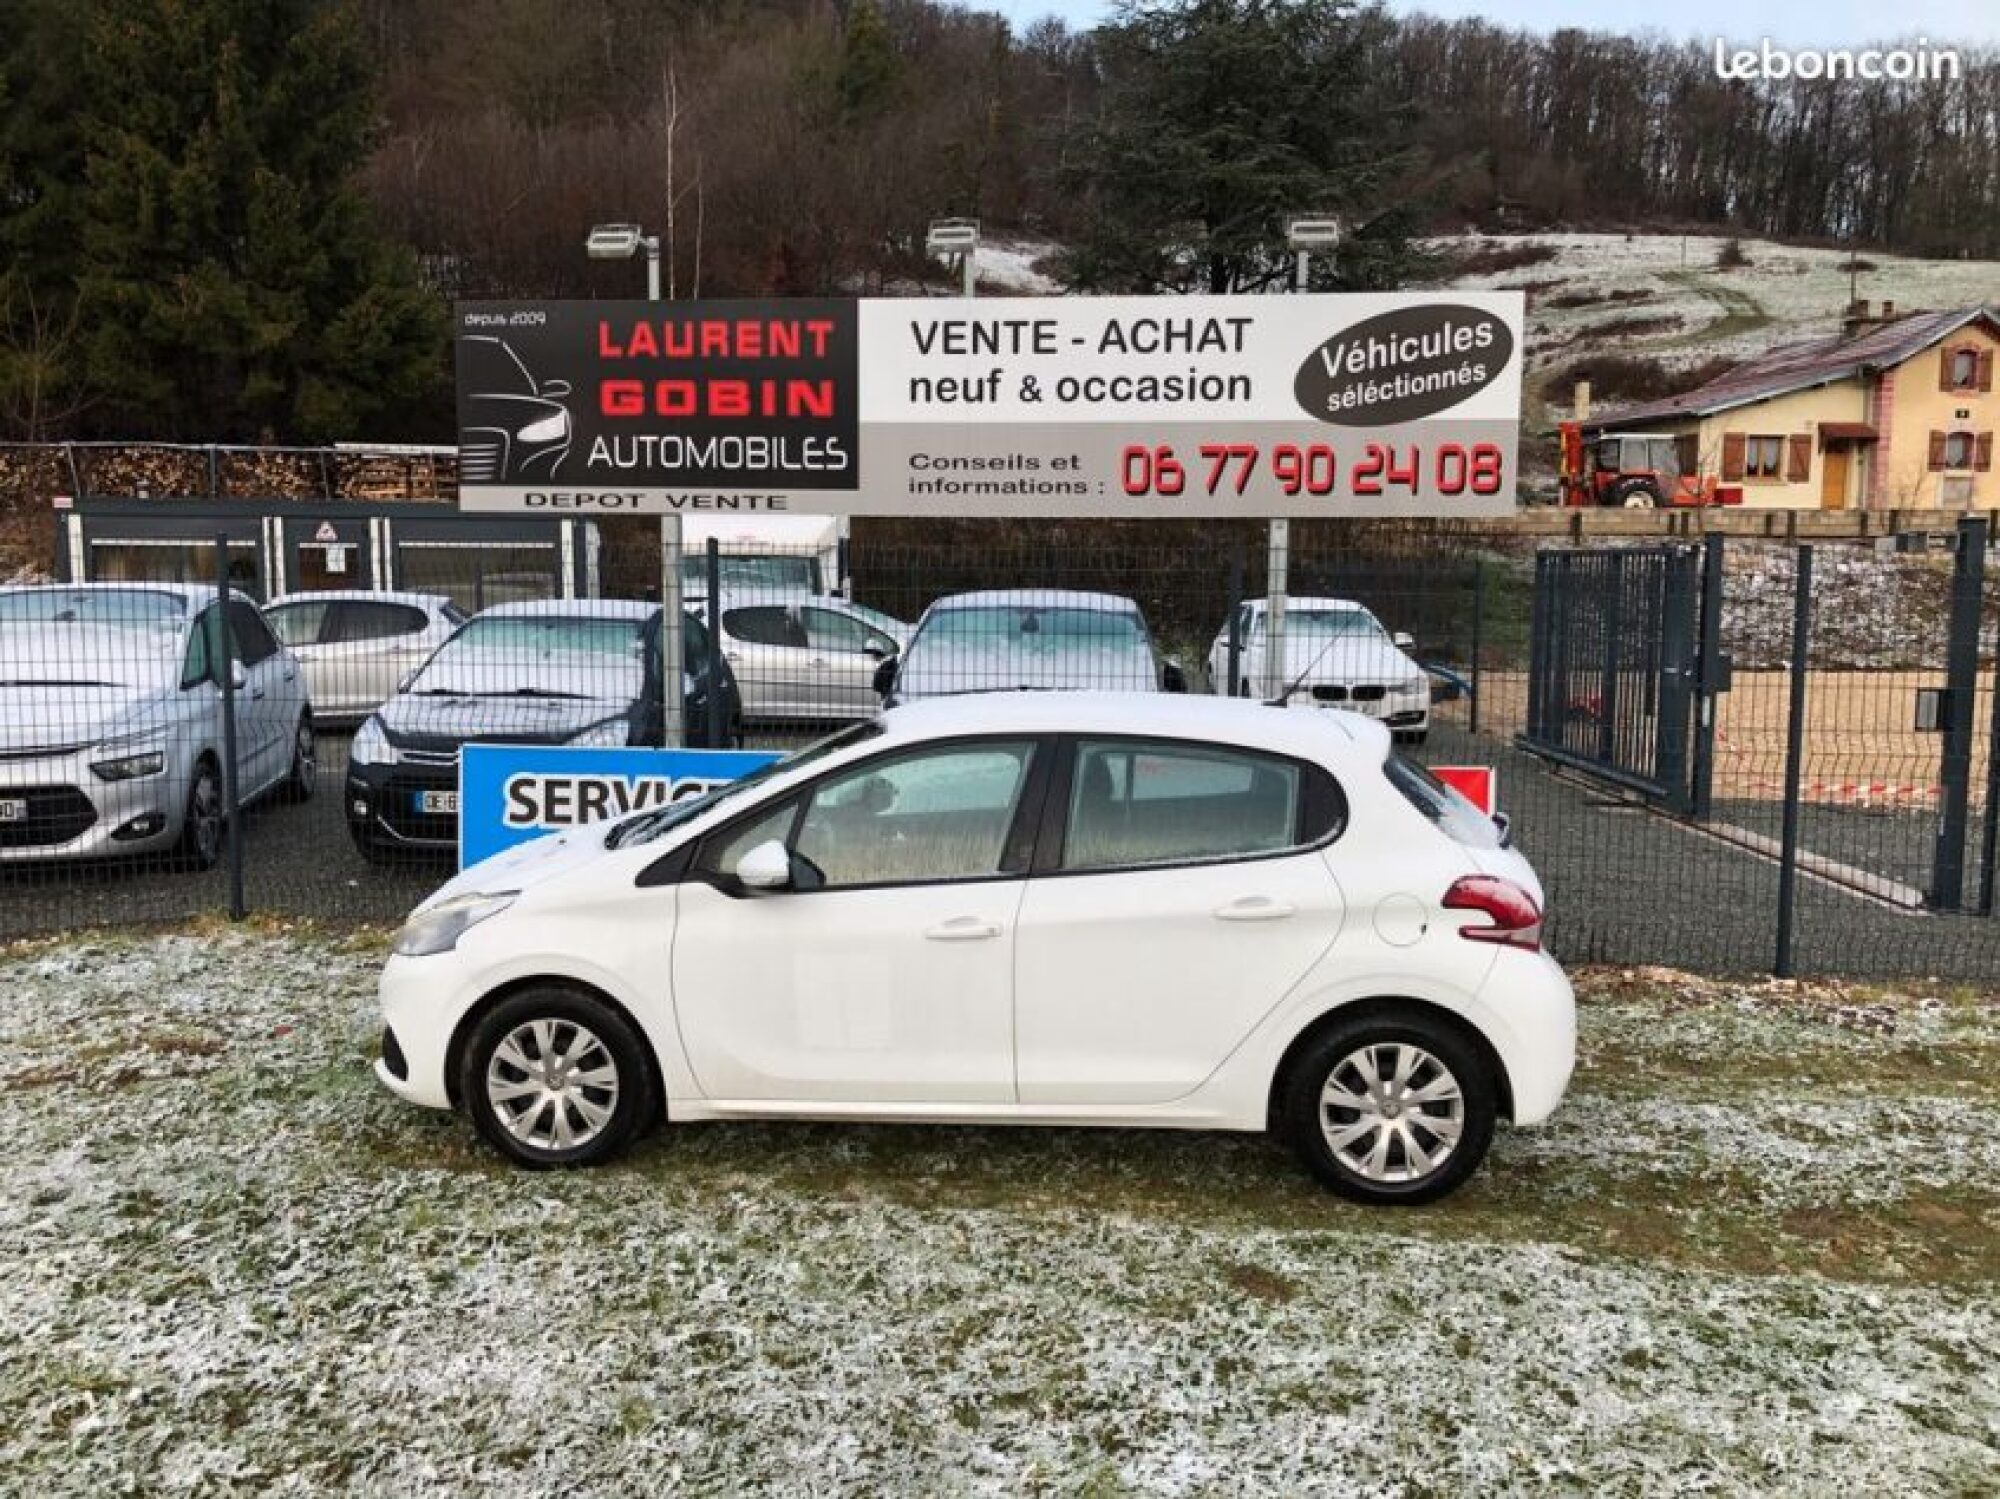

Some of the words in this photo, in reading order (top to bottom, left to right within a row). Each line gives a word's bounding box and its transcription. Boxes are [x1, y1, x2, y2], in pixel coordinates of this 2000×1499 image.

[464, 312, 505, 328] depuis
[509, 310, 547, 326] 2009
[911, 321, 1058, 355] VENTE
[1097, 317, 1254, 354] ACHAT
[600, 319, 834, 358] LAURENT
[1321, 320, 1494, 379] Véhicules
[600, 379, 834, 417] GOBIN
[909, 368, 1004, 403] neuf
[1018, 375, 1043, 402] &
[1055, 366, 1252, 403] occasion
[1326, 360, 1487, 412] séléctionnés
[587, 435, 849, 471] AUTOMOBILES
[908, 452, 1042, 471] Conseils
[1049, 453, 1082, 471] et
[1121, 444, 1185, 496] 06
[1199, 444, 1260, 496] 77
[1272, 444, 1336, 496] 90
[1351, 444, 1420, 497] 24
[1435, 443, 1503, 496] 08
[523, 492, 646, 508] DEPOT
[665, 494, 789, 511] VENTE
[908, 476, 1088, 495] informations
